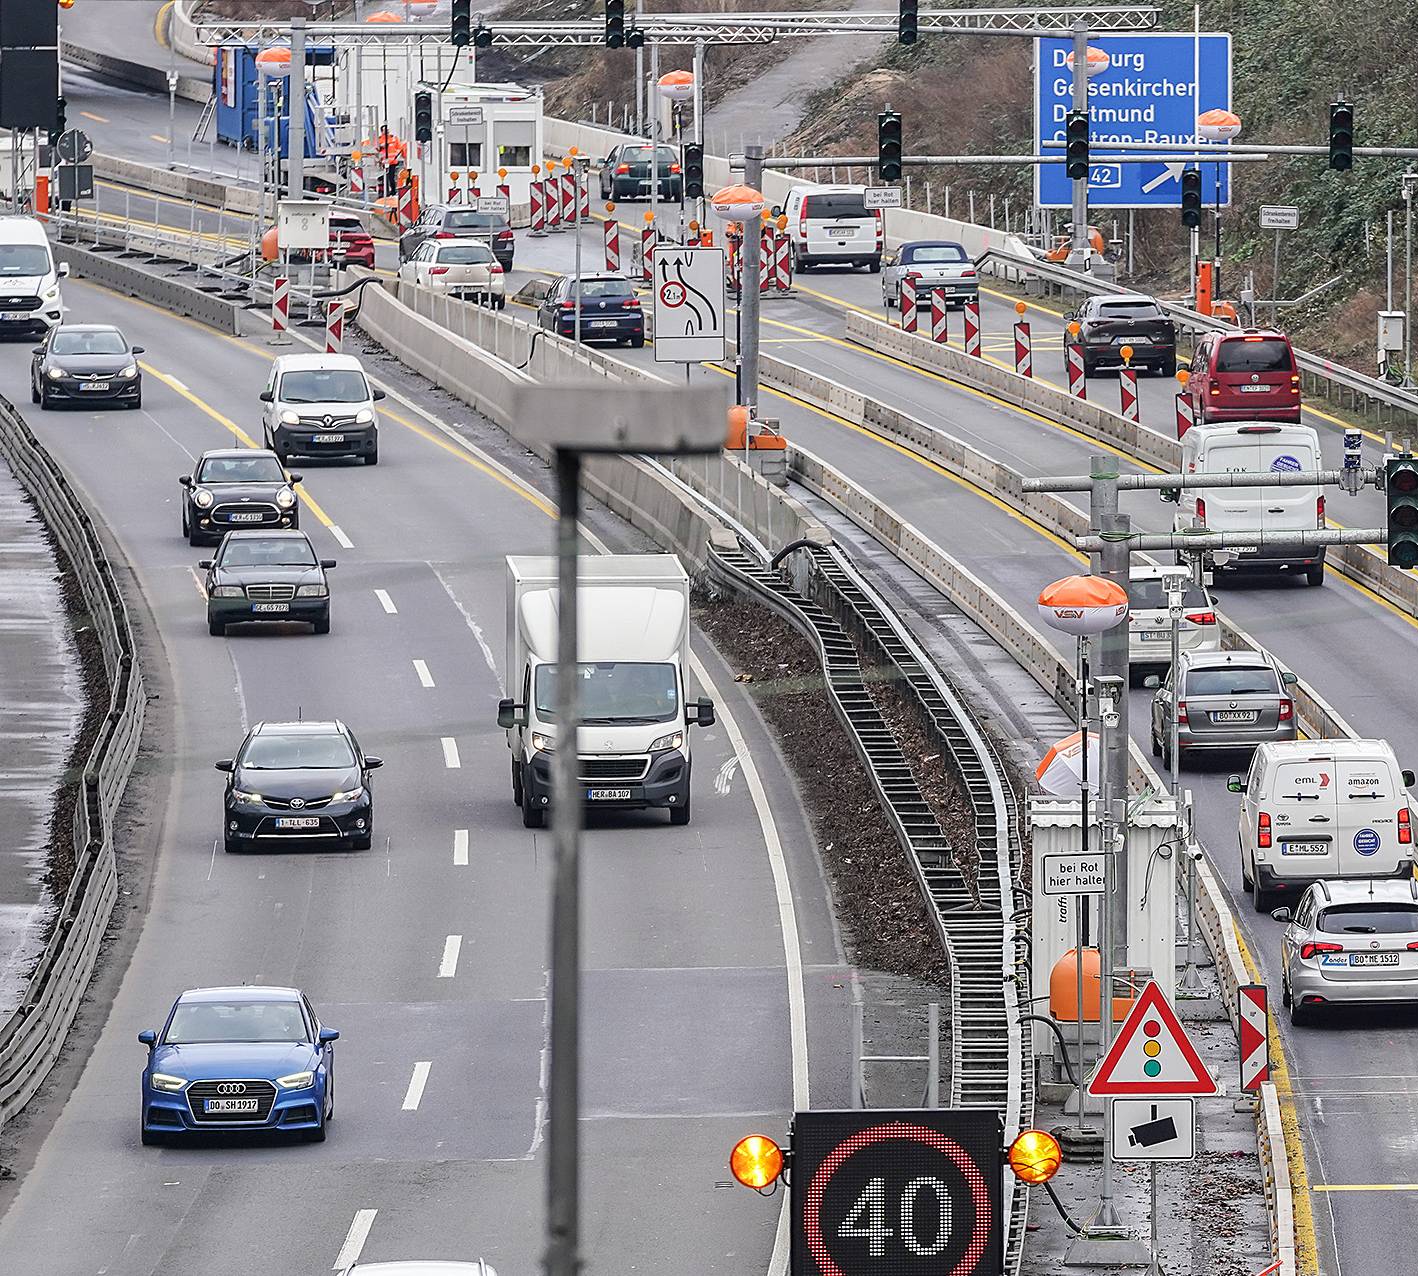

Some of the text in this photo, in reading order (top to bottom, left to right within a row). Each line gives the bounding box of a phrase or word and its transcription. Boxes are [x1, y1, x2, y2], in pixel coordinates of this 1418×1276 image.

[1053, 48, 1145, 71] Durg
[1053, 103, 1155, 122] Dtmund
[1091, 168, 1112, 183] 42
[1053, 610, 1085, 619] VSV
[1059, 862, 1098, 873] bei Rot
[1049, 876, 1071, 886] hier
[237, 1100, 257, 1109] 1917
[837, 1177, 953, 1257] 40
